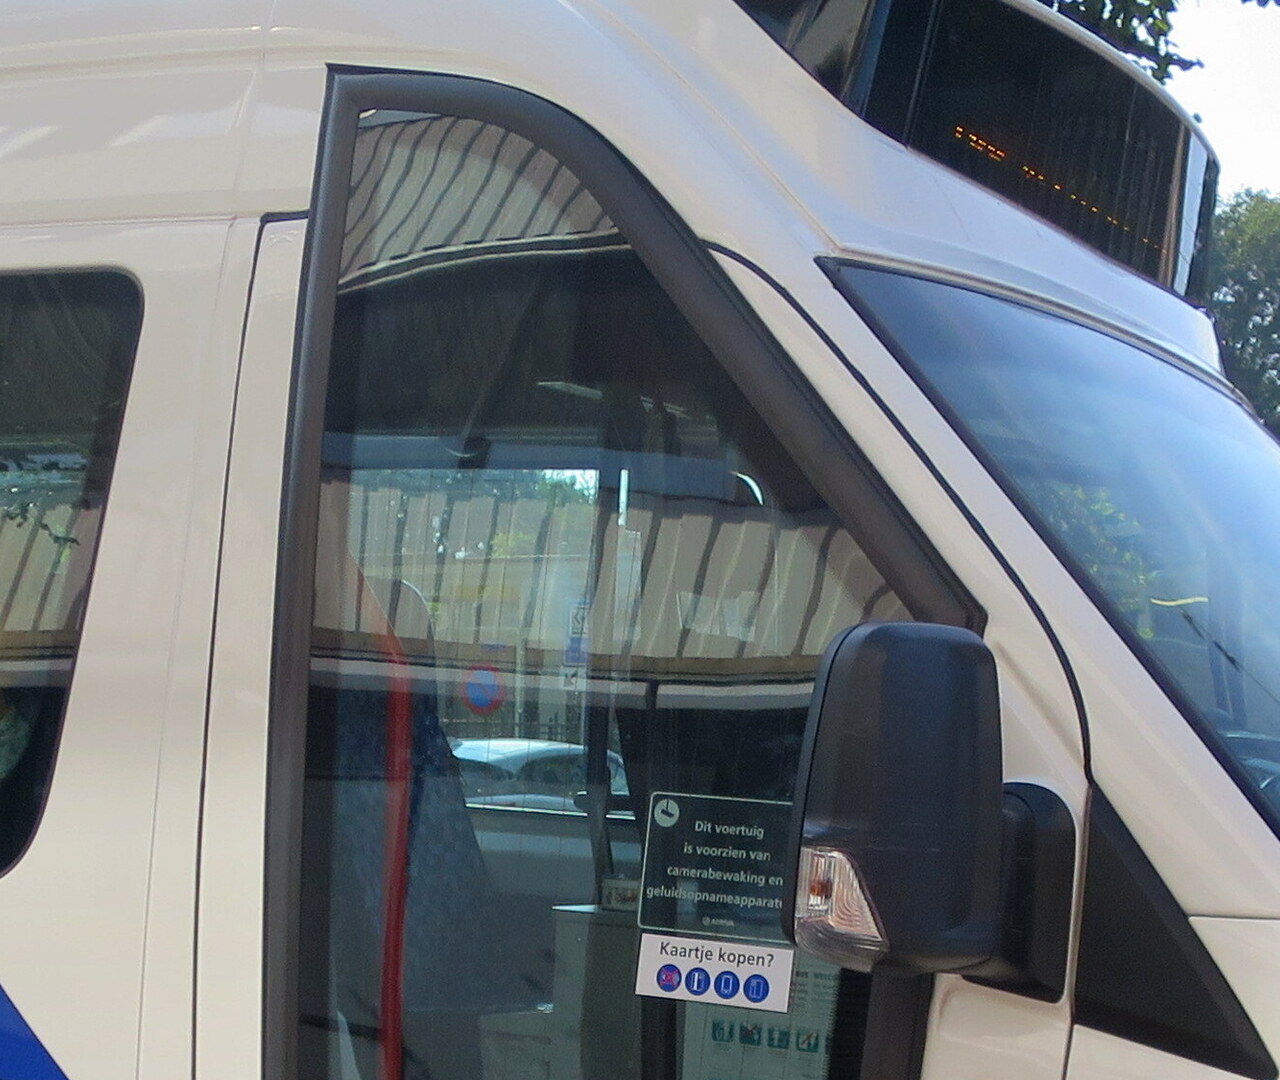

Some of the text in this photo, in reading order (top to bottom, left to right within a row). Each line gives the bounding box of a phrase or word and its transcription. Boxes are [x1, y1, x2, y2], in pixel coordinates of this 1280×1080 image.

[694, 820, 765, 839] Dit voertuig
[683, 842, 771, 862] is voorzien van
[667, 865, 784, 887] camerabewaking en
[646, 885, 783, 909] geluidsopnameapparat
[659, 941, 775, 968] Kaartje kopen?
